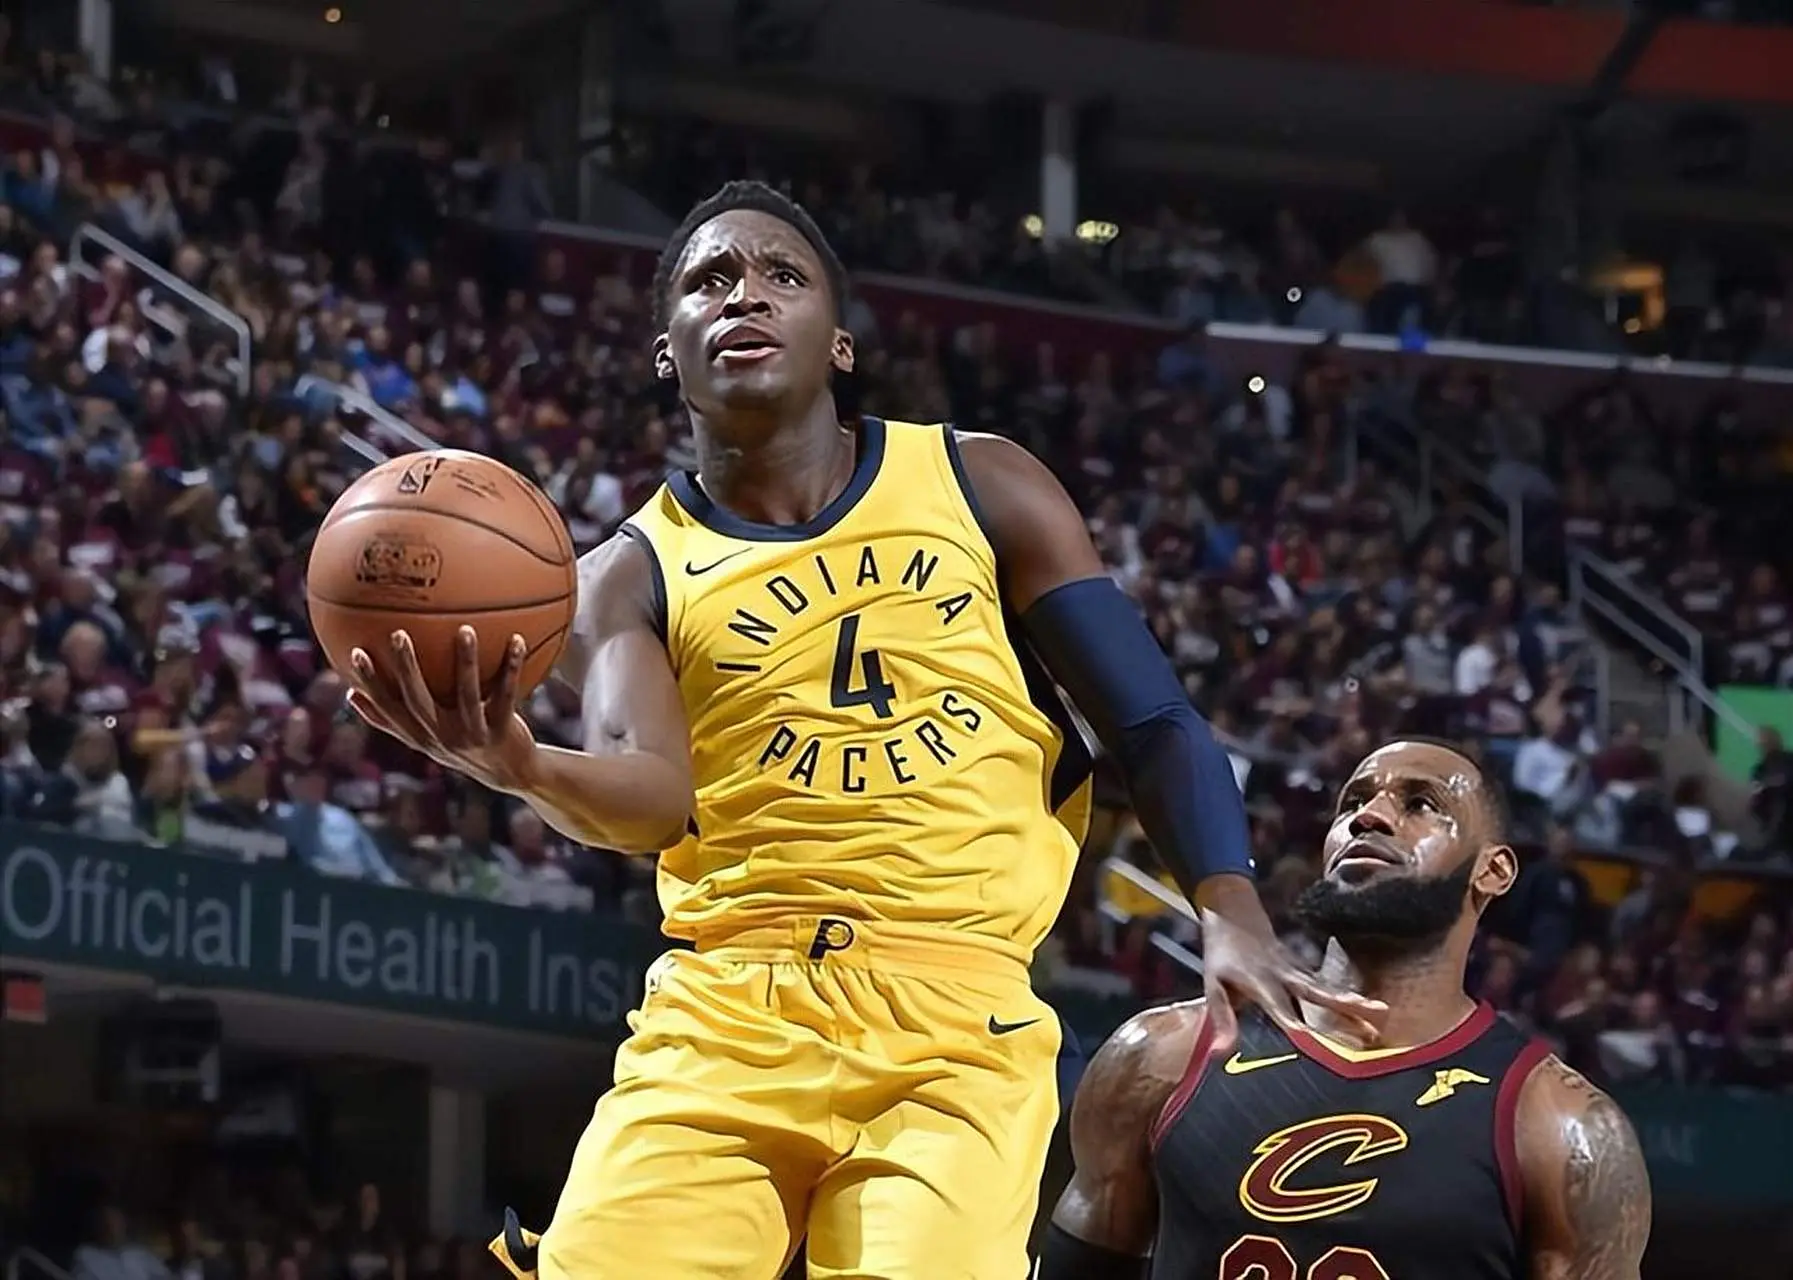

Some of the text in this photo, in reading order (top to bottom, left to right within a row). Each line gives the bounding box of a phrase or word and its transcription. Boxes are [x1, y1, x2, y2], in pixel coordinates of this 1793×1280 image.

[716, 546, 973, 672] INDIANA
[829, 613, 896, 719] 4
[758, 693, 981, 792] PACERS
[3, 846, 253, 969] Official
[279, 888, 500, 1005] Health
[1239, 1114, 1408, 1223] C
